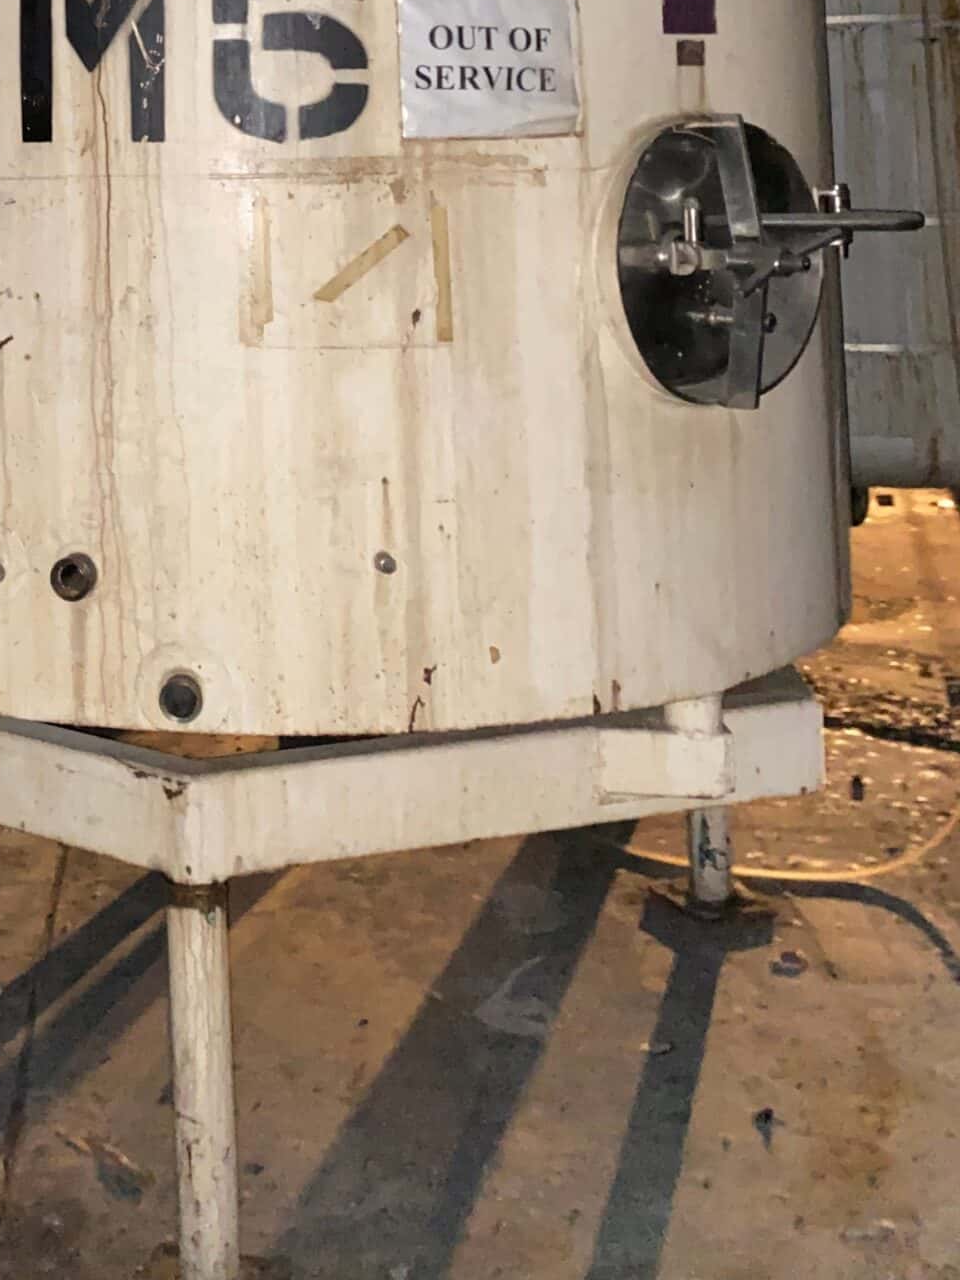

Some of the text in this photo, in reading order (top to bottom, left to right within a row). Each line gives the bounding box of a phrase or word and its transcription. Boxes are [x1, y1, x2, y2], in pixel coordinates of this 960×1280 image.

[429, 24, 552, 52] OUT OF
[415, 65, 557, 92] SERVICE
